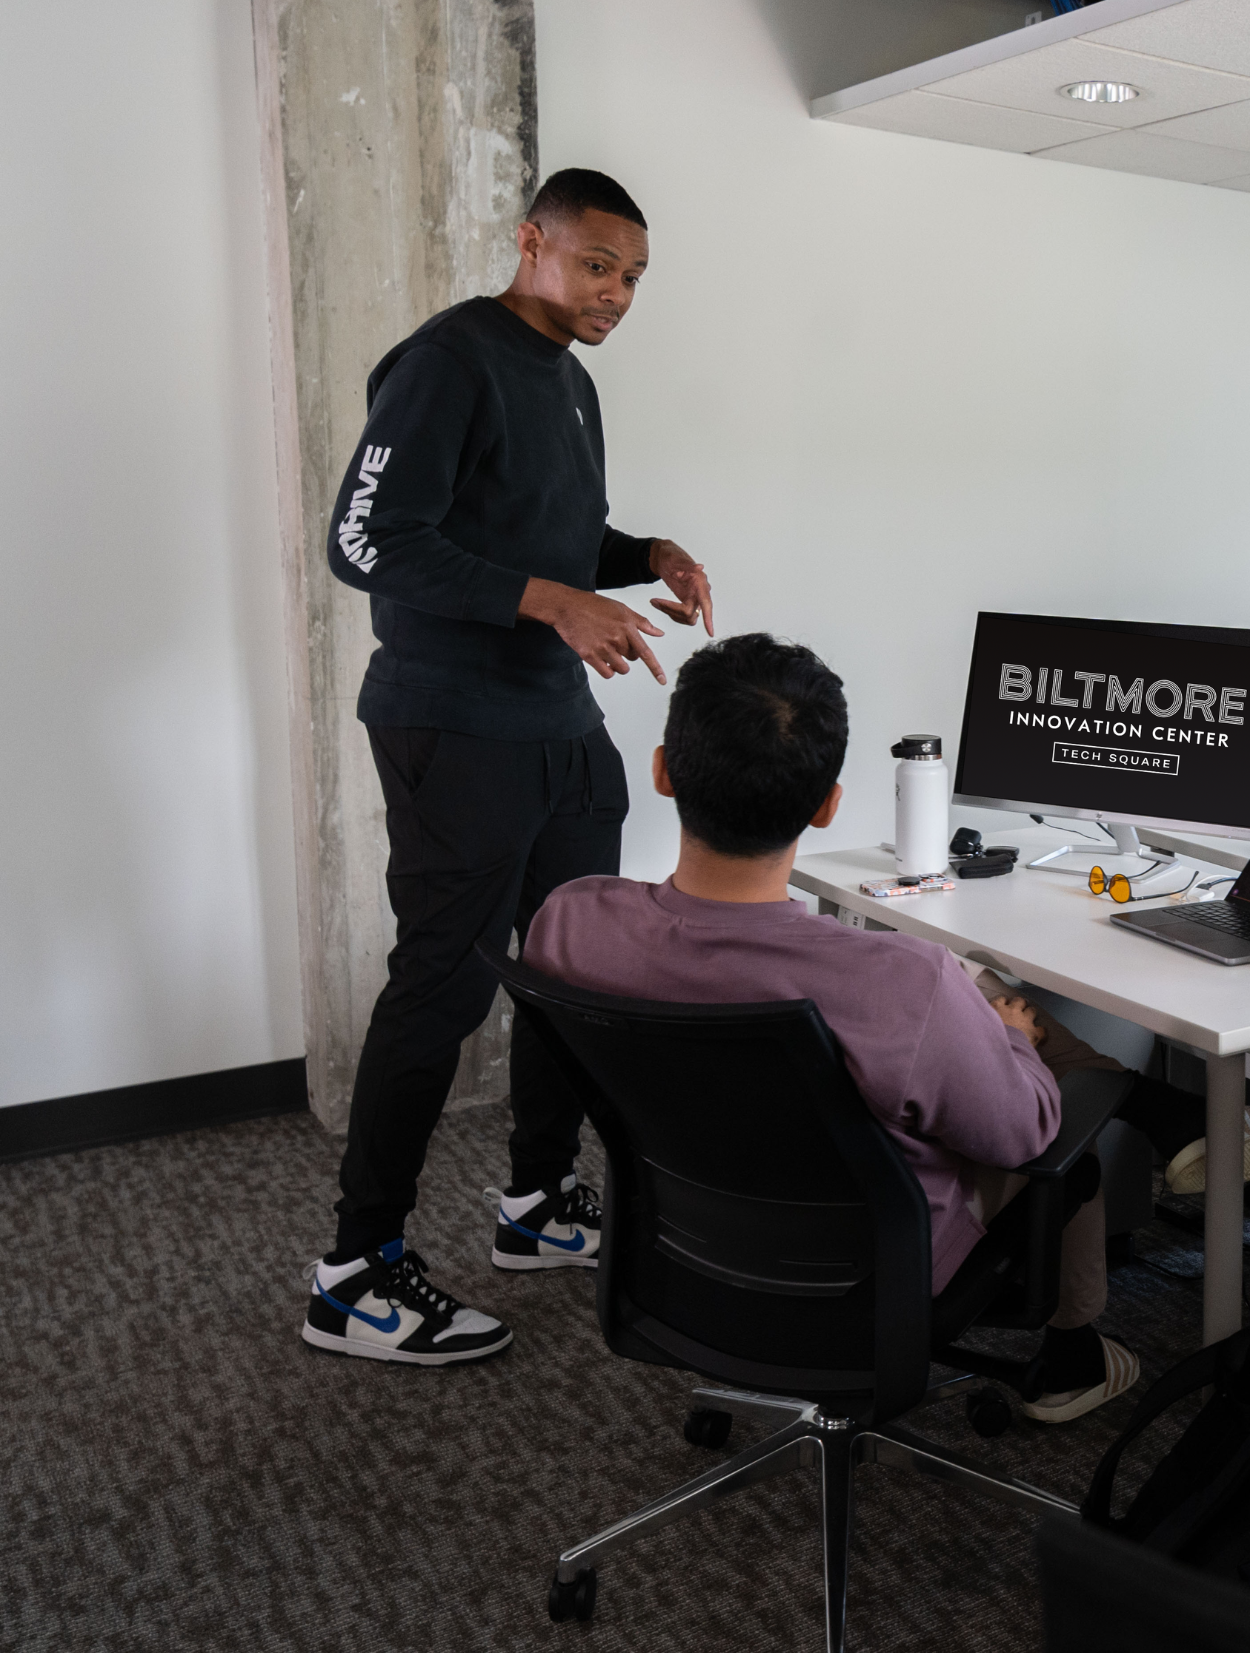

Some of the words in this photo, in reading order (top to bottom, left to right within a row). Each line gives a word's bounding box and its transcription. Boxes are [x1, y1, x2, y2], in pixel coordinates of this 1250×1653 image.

[998, 663, 1248, 725] BILTMORE
[1009, 711, 1143, 738] INNOVATION
[1152, 726, 1230, 748] CENTER
[1061, 748, 1102, 762] TECH
[1108, 753, 1172, 769] SQUARE
